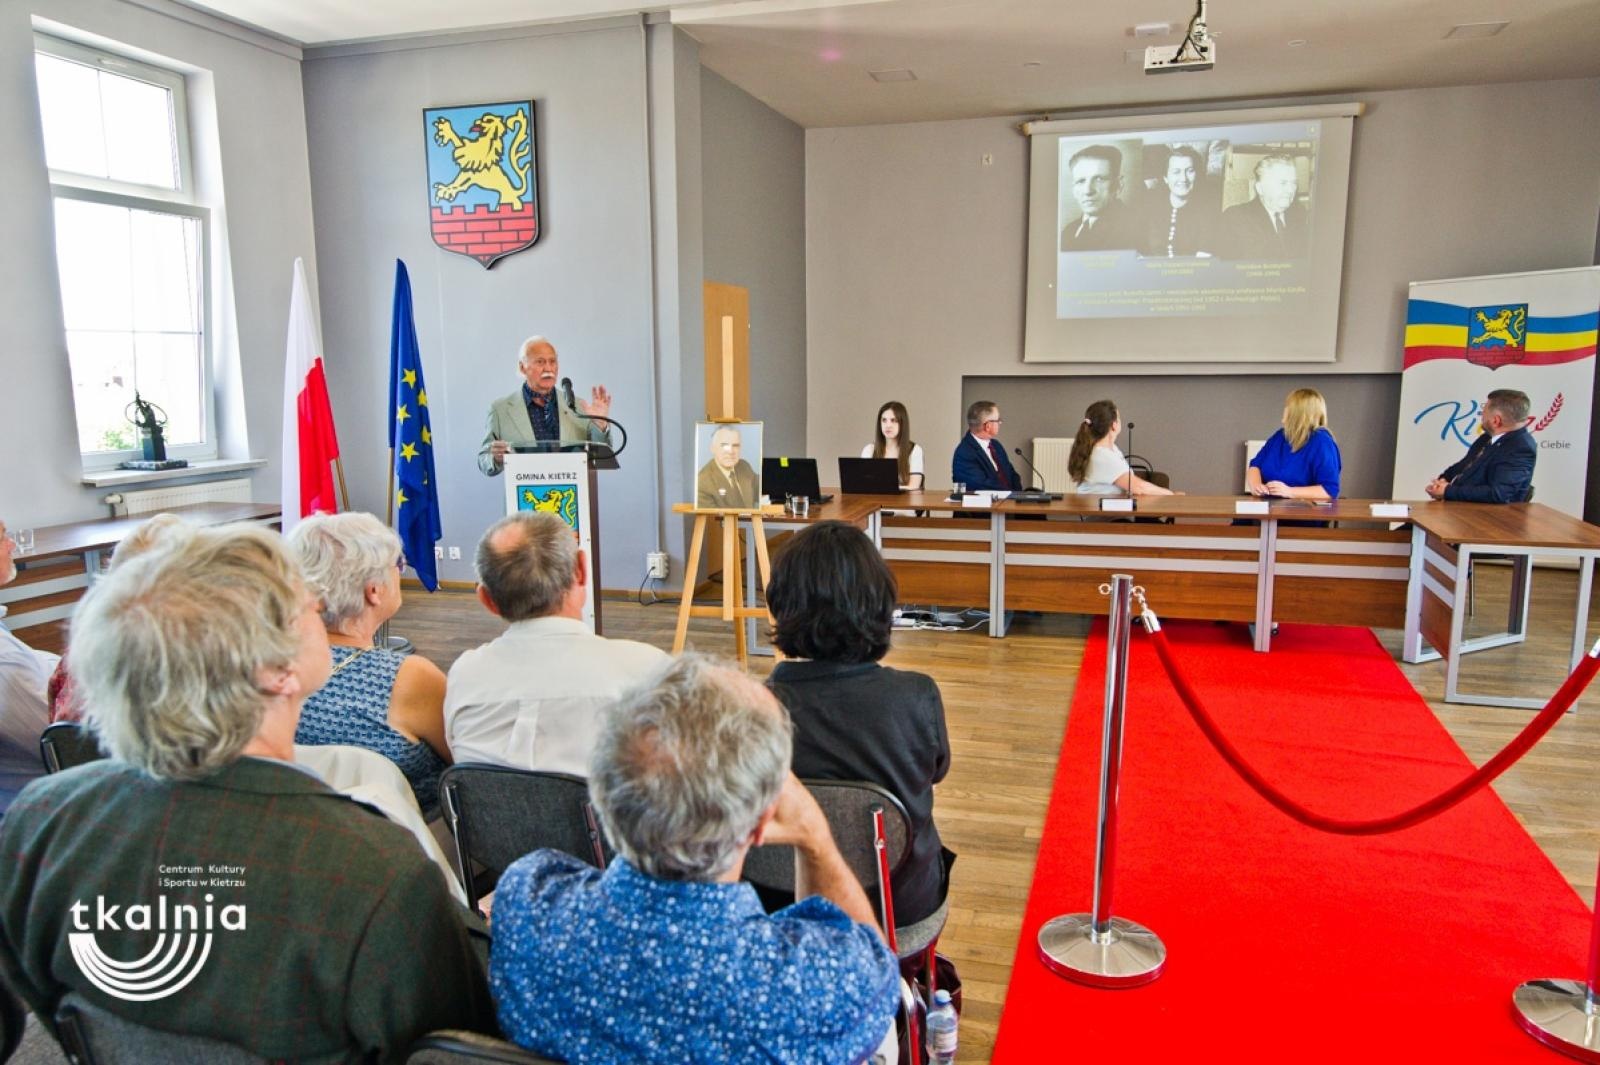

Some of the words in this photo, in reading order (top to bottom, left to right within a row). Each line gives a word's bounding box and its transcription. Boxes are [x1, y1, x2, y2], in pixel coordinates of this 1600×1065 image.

[1540, 440, 1571, 449] Ciebie
[515, 473, 546, 481] GMINA
[548, 472, 577, 480] KIETRZ
